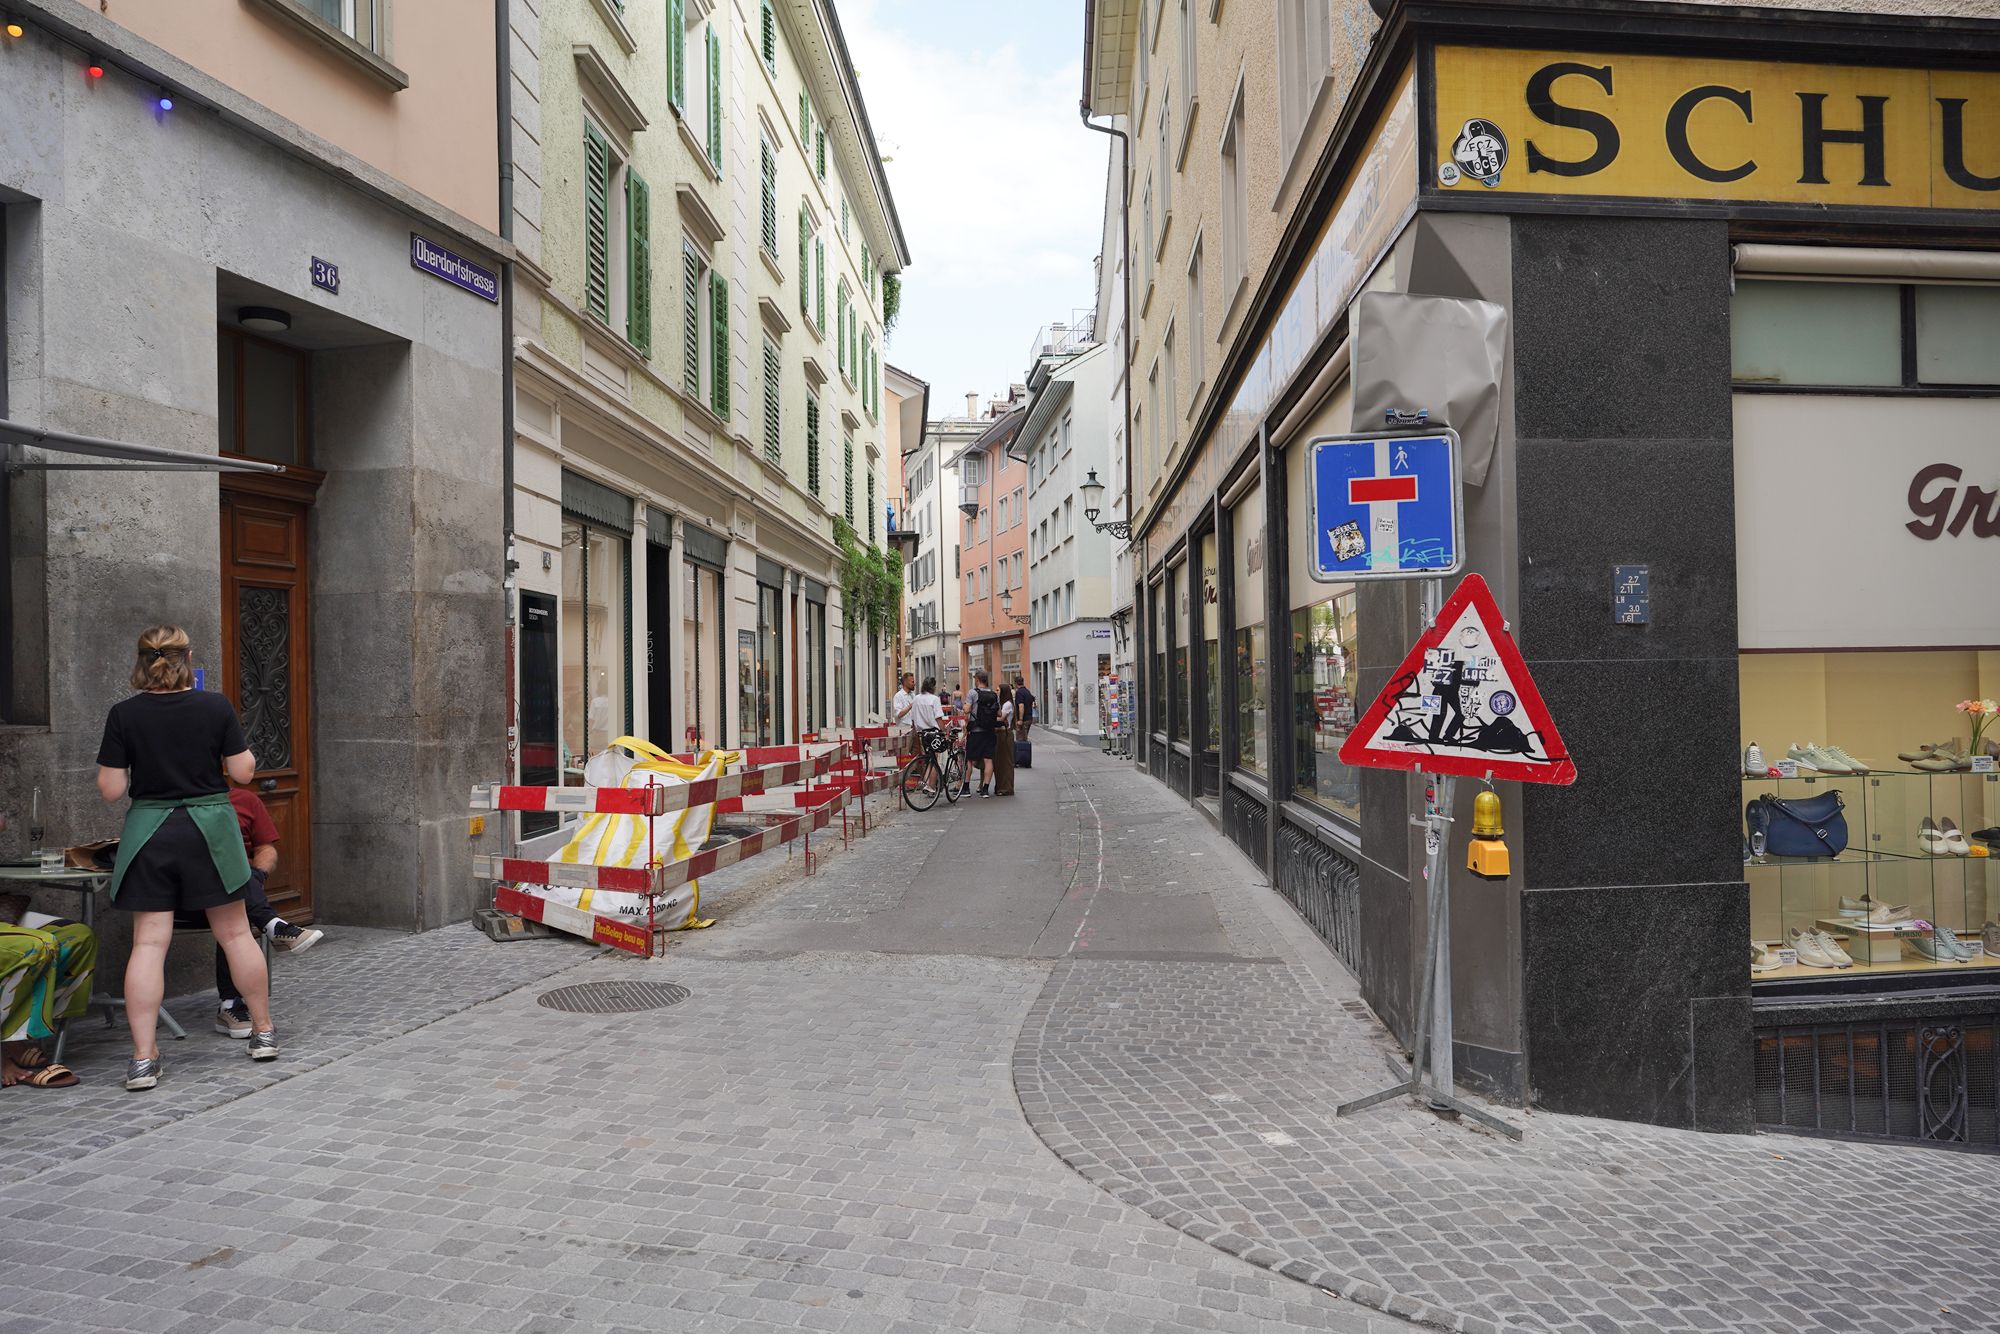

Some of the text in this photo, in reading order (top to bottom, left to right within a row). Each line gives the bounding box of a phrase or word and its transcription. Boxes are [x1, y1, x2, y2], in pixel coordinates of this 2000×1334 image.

[315, 262, 336, 287] 36
[416, 238, 495, 294] Oberdorfstrasse
[1905, 462, 2000, 540] Gr
[1615, 567, 1620, 575] S
[1620, 586, 1630, 594] 2.1
[619, 905, 644, 916] MAX.
